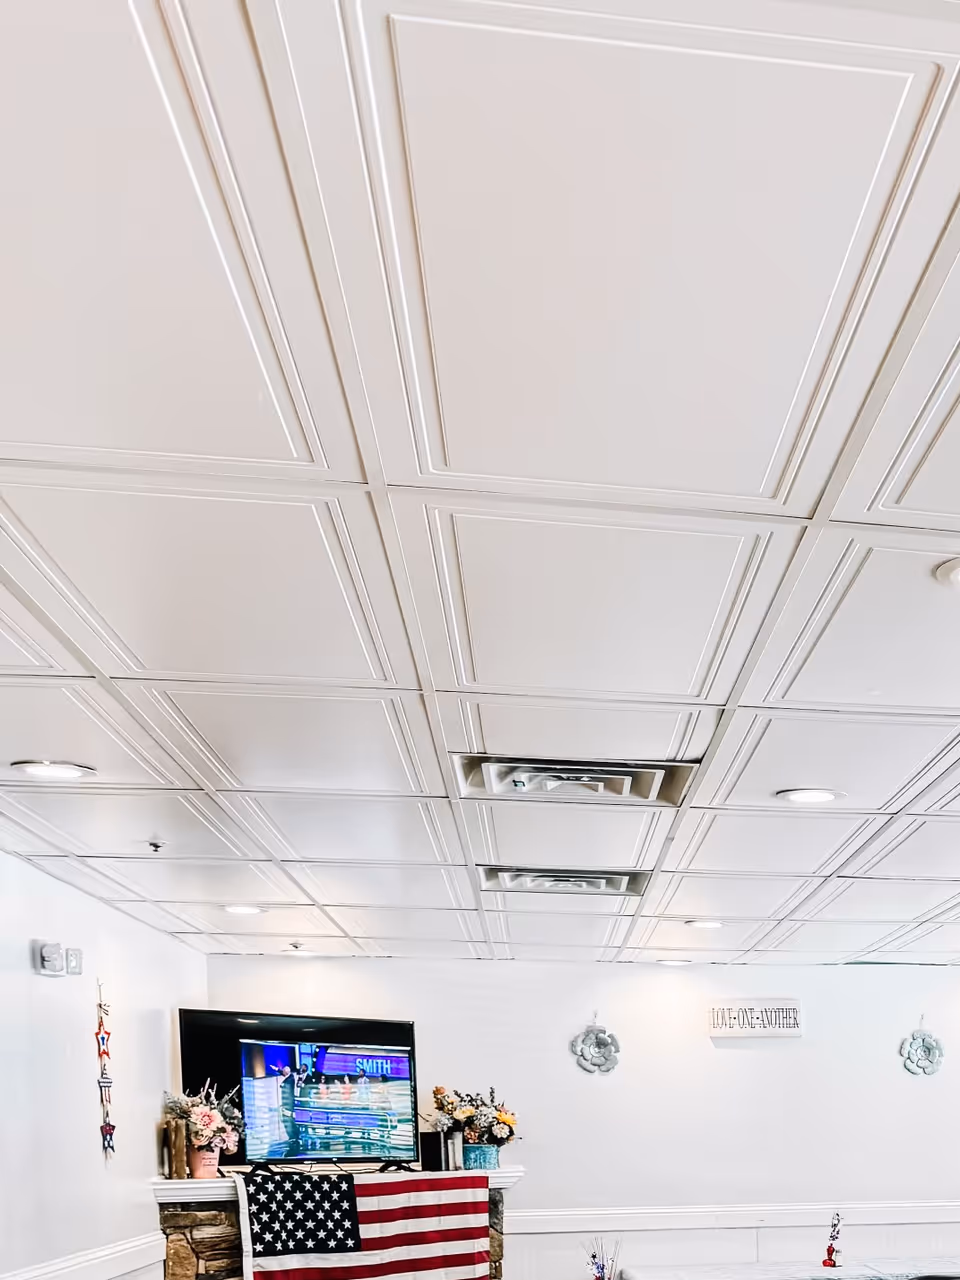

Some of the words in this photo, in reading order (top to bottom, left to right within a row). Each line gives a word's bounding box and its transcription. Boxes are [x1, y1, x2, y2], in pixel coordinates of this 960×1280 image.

[712, 1007, 734, 1029] LOVE
[737, 1007, 755, 1029] ONE
[759, 1007, 799, 1029] ANOTHER
[355, 1058, 391, 1074] SMITH
